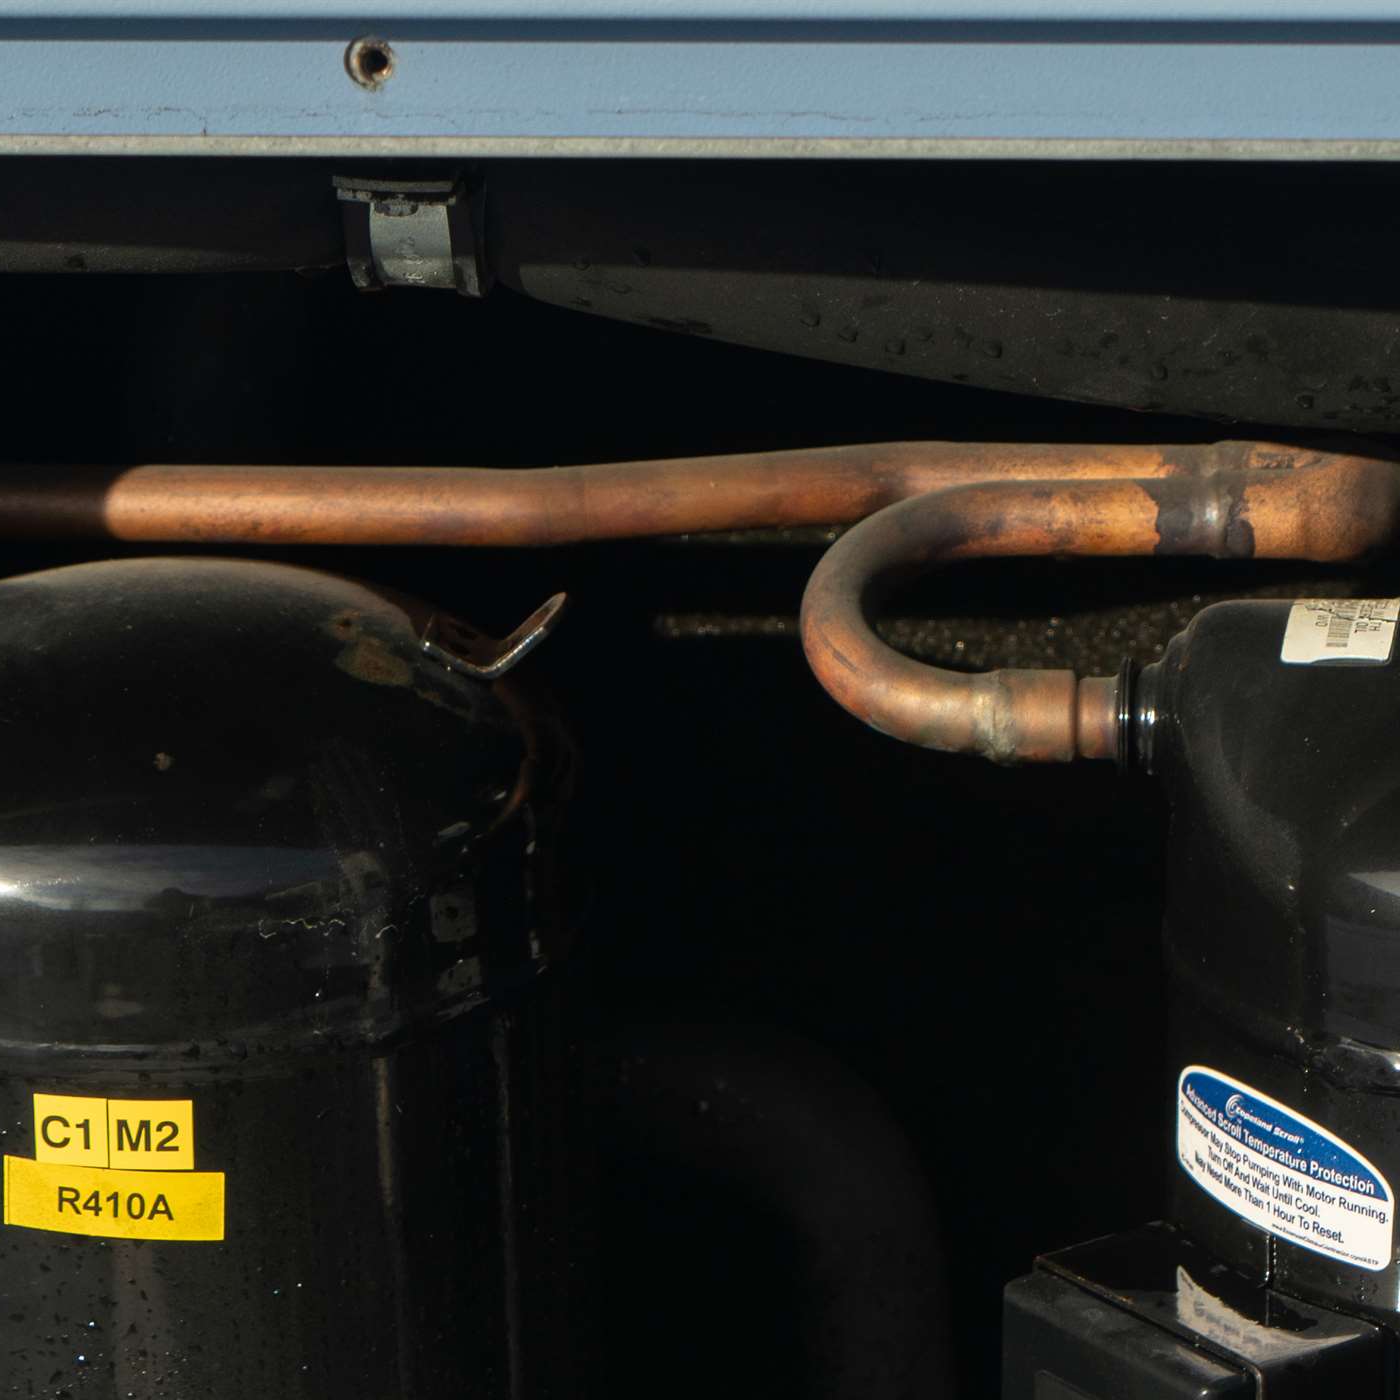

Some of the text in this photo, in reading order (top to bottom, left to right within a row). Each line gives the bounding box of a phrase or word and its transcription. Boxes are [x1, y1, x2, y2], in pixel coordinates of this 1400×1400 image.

[40, 1114, 180, 1152] C1 M2
[1217, 1112, 1243, 1140] Scroll
[1242, 1128, 1308, 1172] Temperature
[1310, 1160, 1376, 1195] Protection
[57, 1185, 175, 1222] R410A
[1207, 1145, 1222, 1167] Turn
[1222, 1158, 1234, 1175] Off
[1234, 1167, 1250, 1186] And
[1251, 1176, 1270, 1198] Wait
[1271, 1187, 1294, 1207] Until
[1294, 1197, 1321, 1219] Cool.
[1210, 1131, 1225, 1153] May
[1224, 1142, 1242, 1163] Stop
[1242, 1154, 1281, 1186] Pumping
[1282, 1173, 1304, 1194] With
[1305, 1184, 1336, 1206] Motor
[1338, 1196, 1389, 1225] Running.
[1223, 1175, 1243, 1198] More
[1243, 1187, 1265, 1210] Than
[1273, 1203, 1296, 1225] Hour
[1298, 1214, 1311, 1232] To
[1311, 1220, 1345, 1245] Reset.
